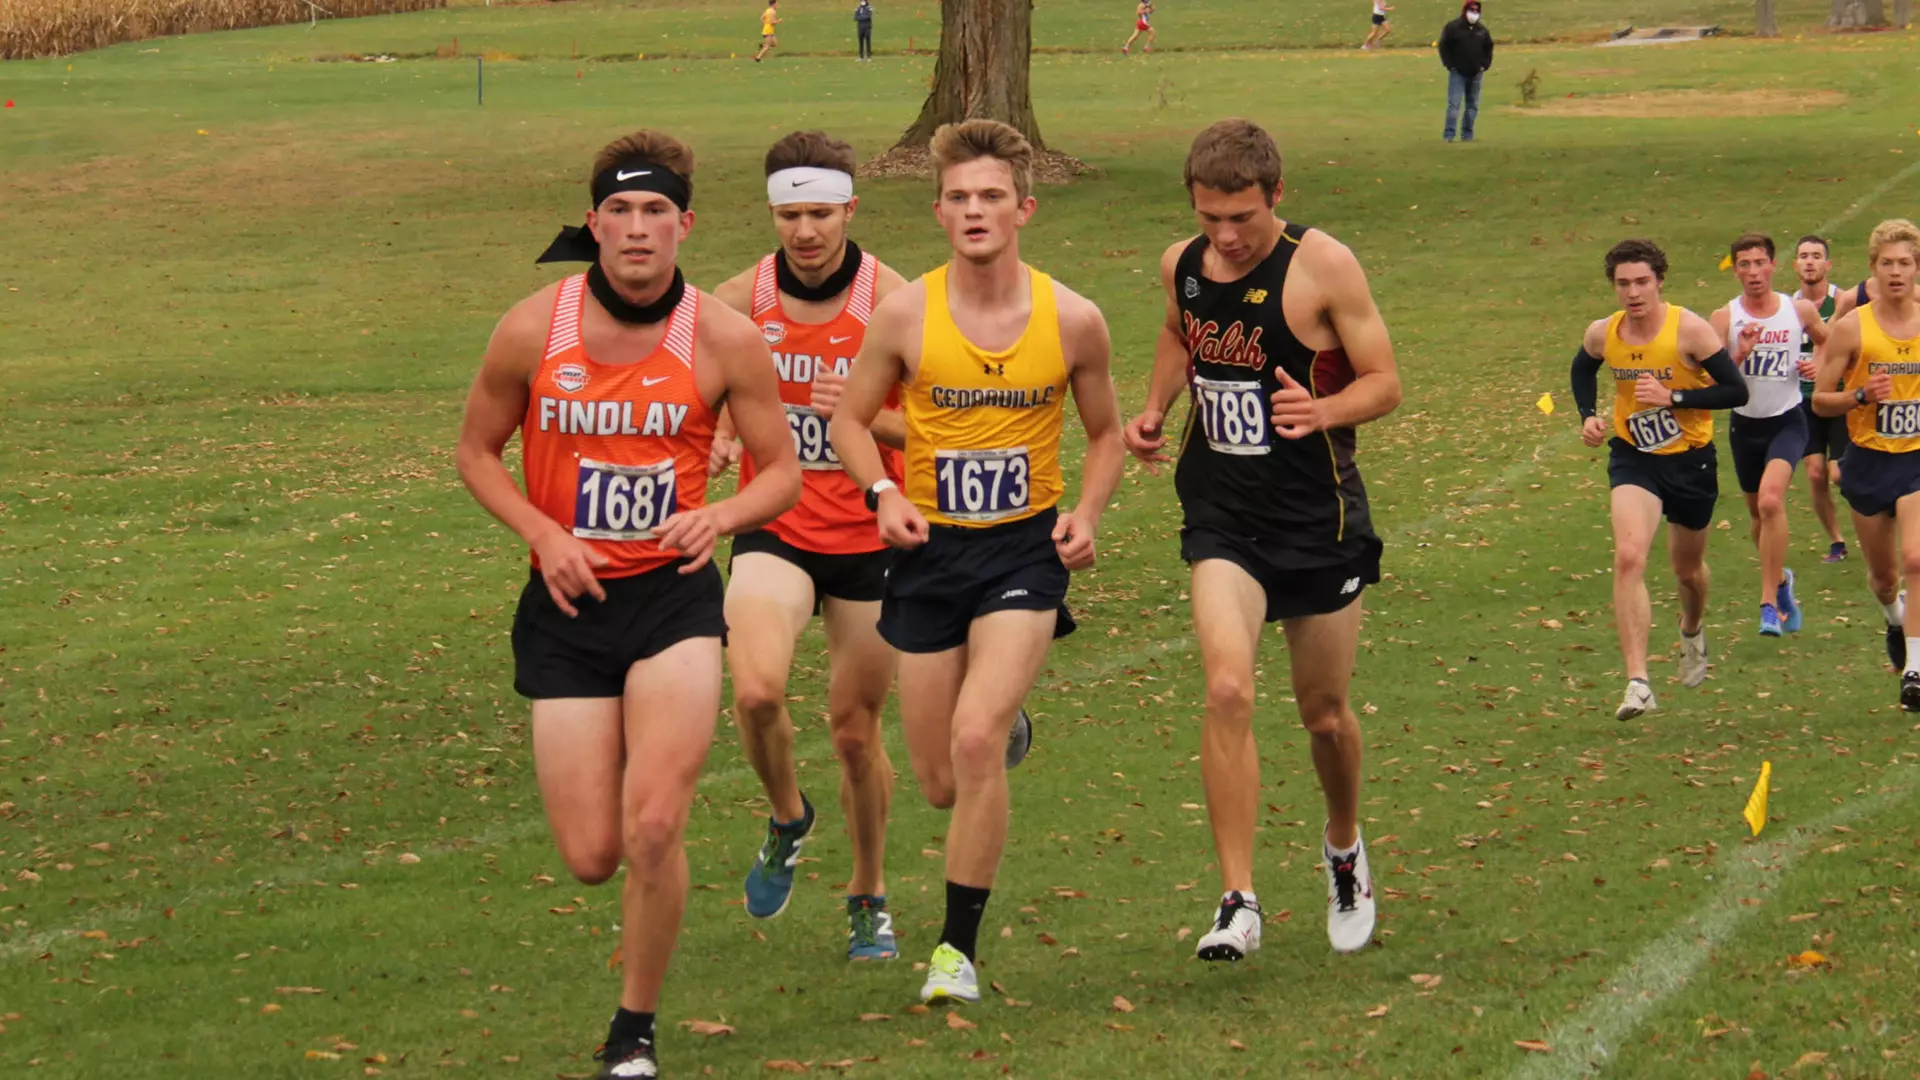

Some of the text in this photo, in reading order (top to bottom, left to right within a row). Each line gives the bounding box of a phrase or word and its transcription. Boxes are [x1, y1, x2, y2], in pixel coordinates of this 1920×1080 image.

[1184, 309, 1267, 371] Walsh
[1757, 329, 1790, 344] LONE
[1746, 350, 1789, 378] 1724
[539, 396, 690, 437] FINDLAY
[931, 385, 1055, 409] CEDARVILLE
[1196, 385, 1265, 445] 1789
[1629, 408, 1679, 447] 1676
[1878, 403, 1920, 434] 168
[582, 468, 675, 531] 1687
[940, 455, 1029, 512] 1673
